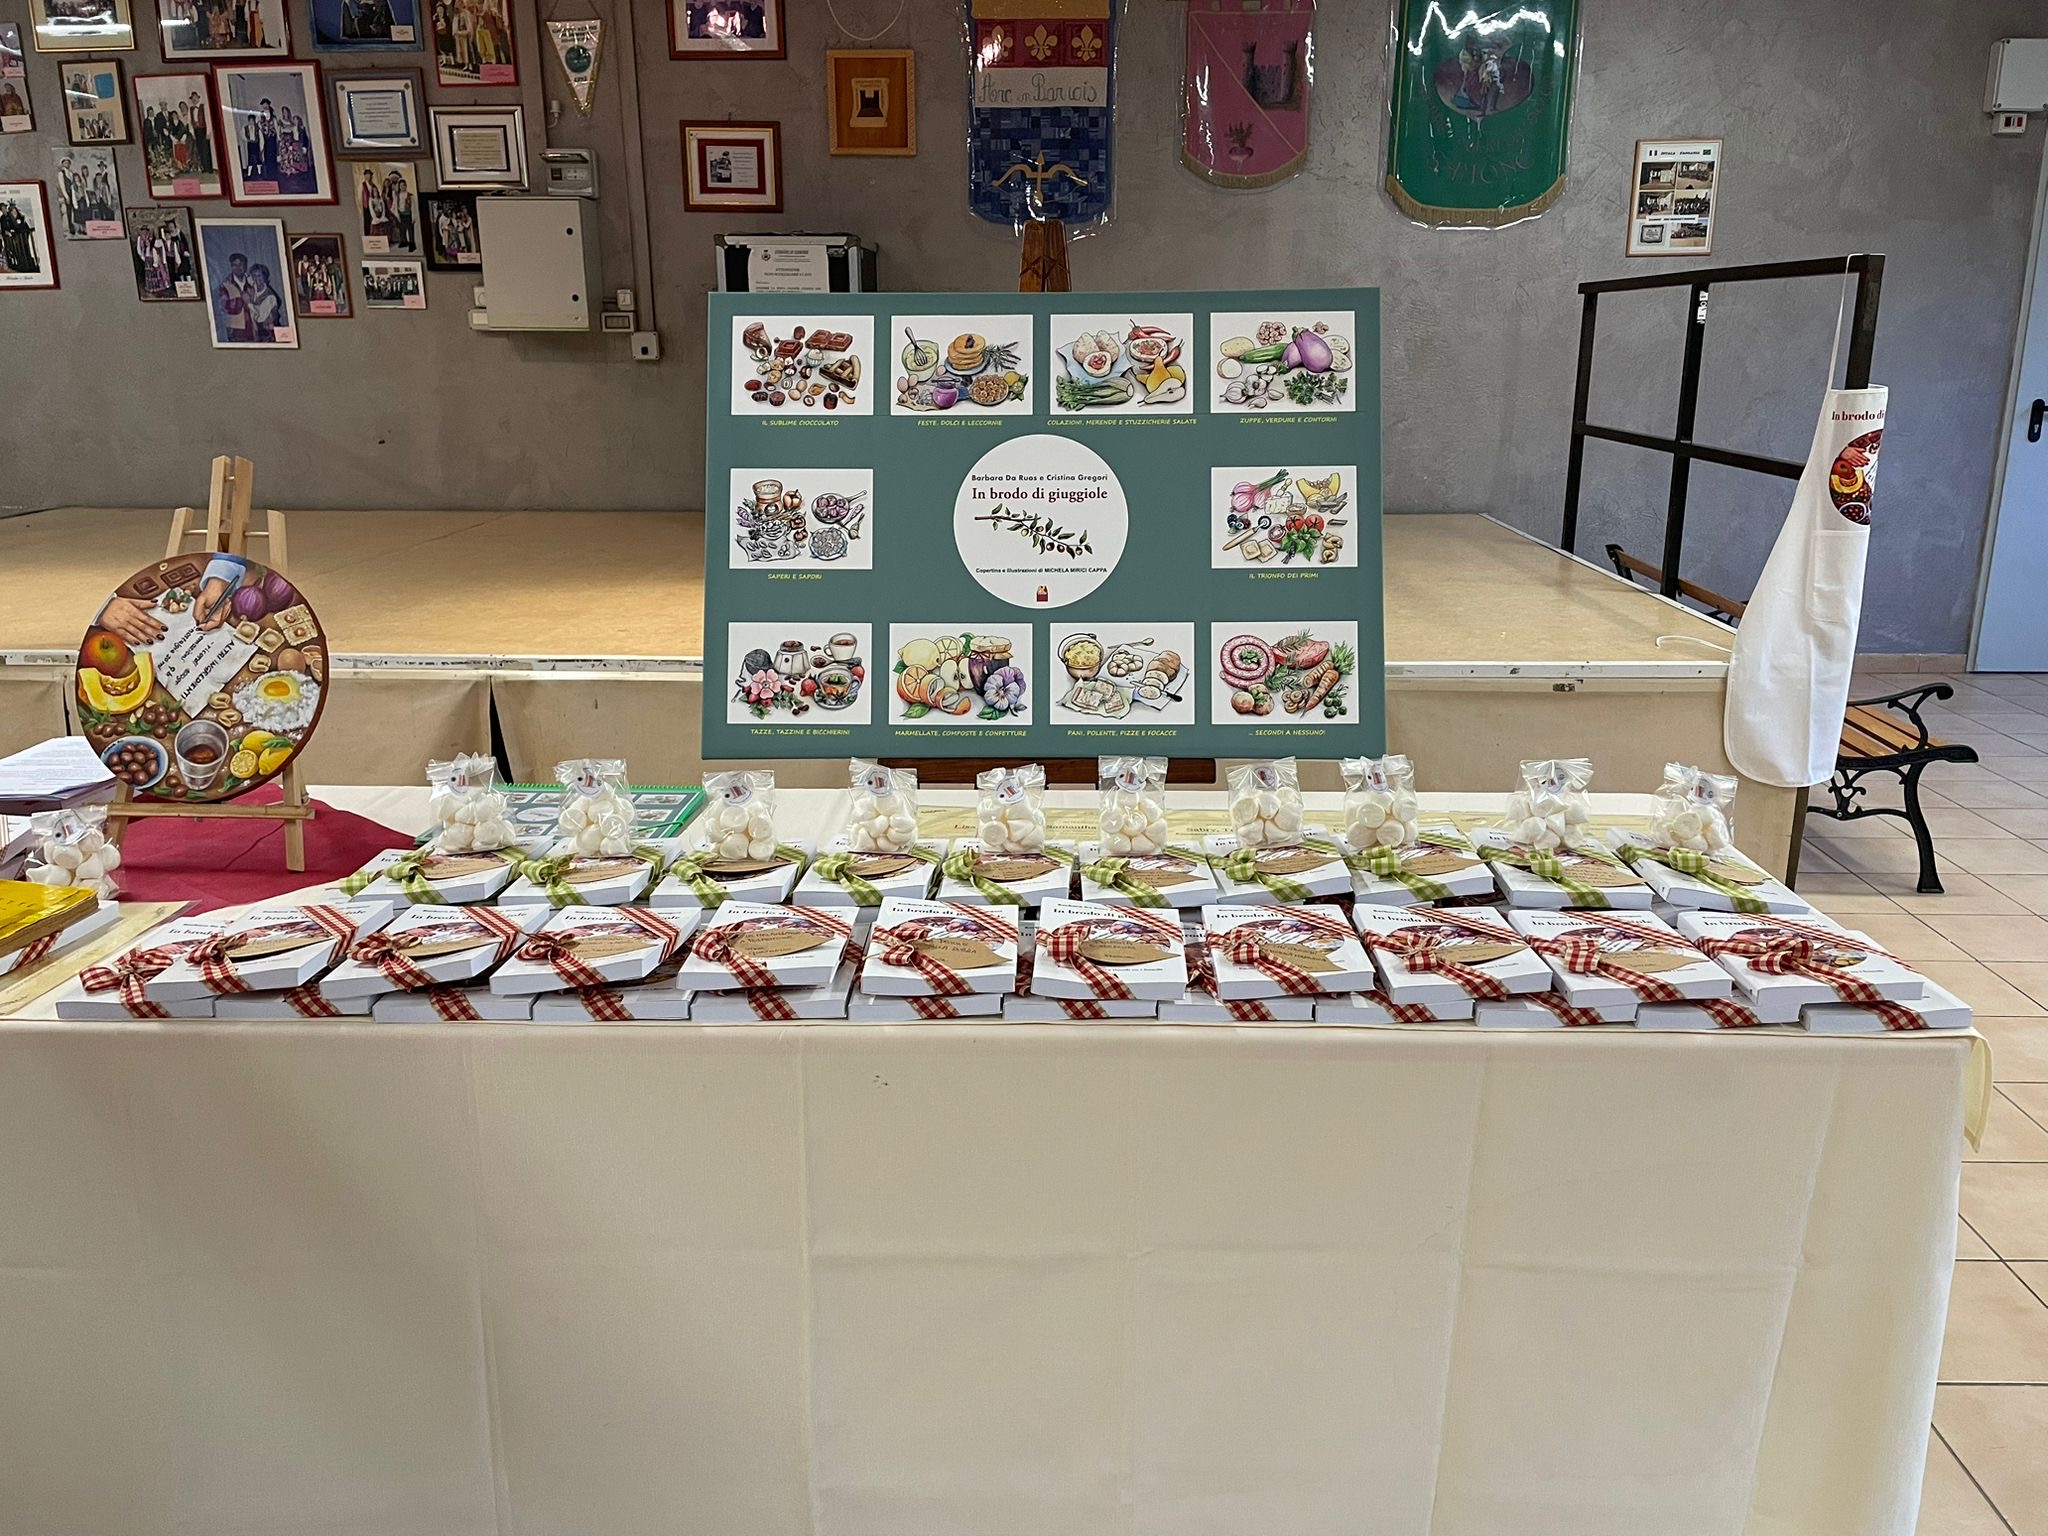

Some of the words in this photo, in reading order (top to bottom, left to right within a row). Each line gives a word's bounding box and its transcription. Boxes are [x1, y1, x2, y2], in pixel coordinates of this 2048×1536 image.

[1831, 411, 1841, 420] In
[1841, 410, 1875, 421] brodo
[1046, 473, 1075, 481] Cristina
[1077, 473, 1108, 482] Gregori
[972, 487, 986, 499] In
[990, 487, 1028, 499] brodo
[1032, 487, 1045, 499] di
[1048, 487, 1108, 503] giuggiole
[1257, 572, 1286, 580] TRIONFO
[217, 639, 236, 661] ALTRI
[180, 659, 219, 700] INGREDIENTI
[812, 728, 850, 736] BICCHIERINI
[1147, 729, 1177, 737] FOCACCE
